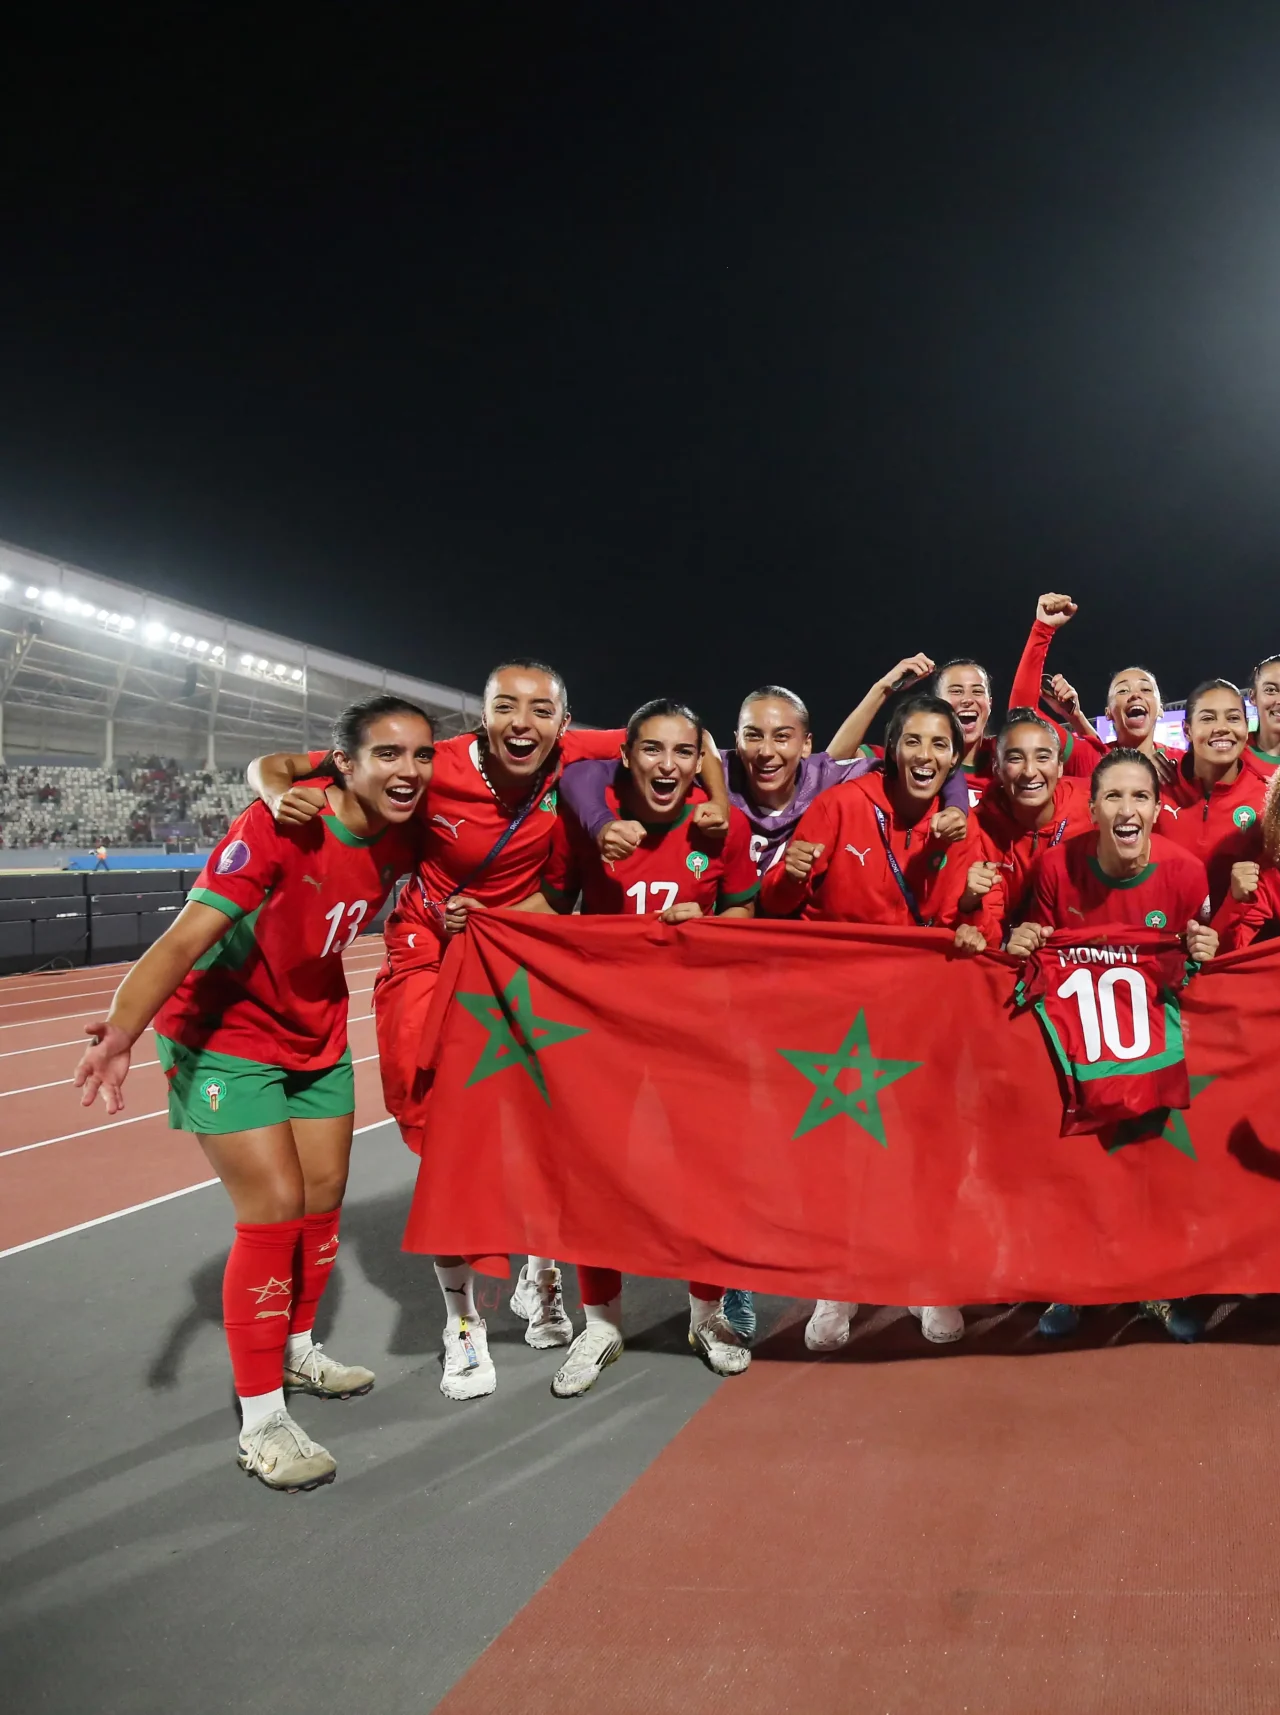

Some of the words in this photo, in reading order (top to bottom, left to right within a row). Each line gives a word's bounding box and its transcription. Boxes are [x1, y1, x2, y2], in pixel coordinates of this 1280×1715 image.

[626, 881, 679, 915] 17
[320, 900, 368, 958] 13
[1057, 945, 1140, 968] MOMMY
[1057, 967, 1151, 1063] 10
